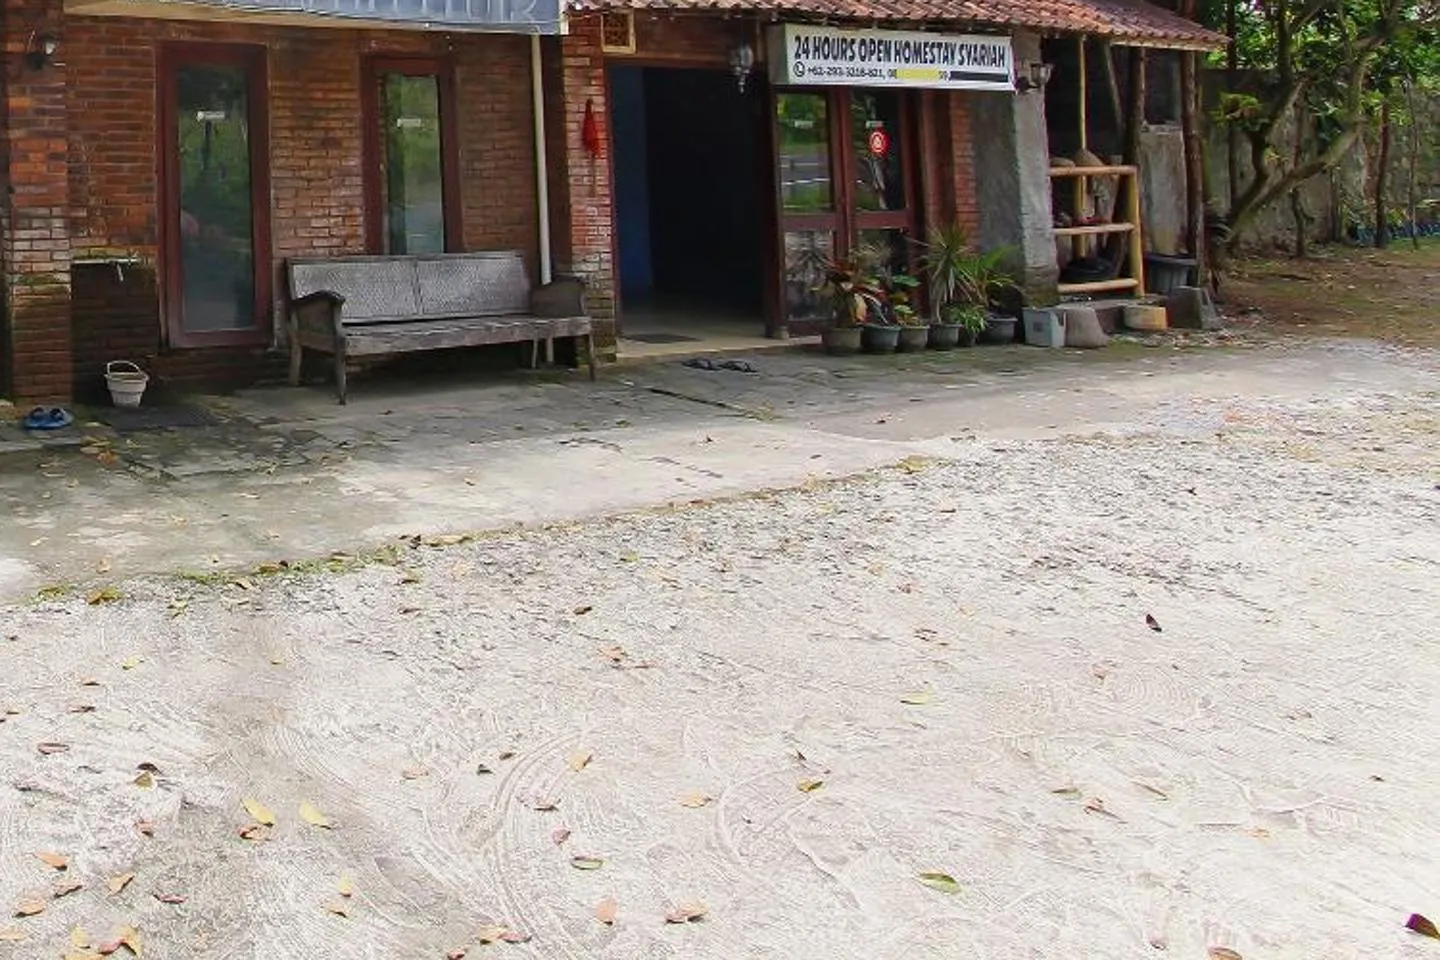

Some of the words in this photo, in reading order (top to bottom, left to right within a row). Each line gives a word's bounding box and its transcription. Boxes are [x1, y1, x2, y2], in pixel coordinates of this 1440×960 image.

[794, 35, 810, 59] 24
[812, 35, 856, 61] HOURS
[858, 38, 892, 62] OPEN
[894, 40, 956, 65] HOMESTAY
[958, 43, 1005, 67] SYARIAH
